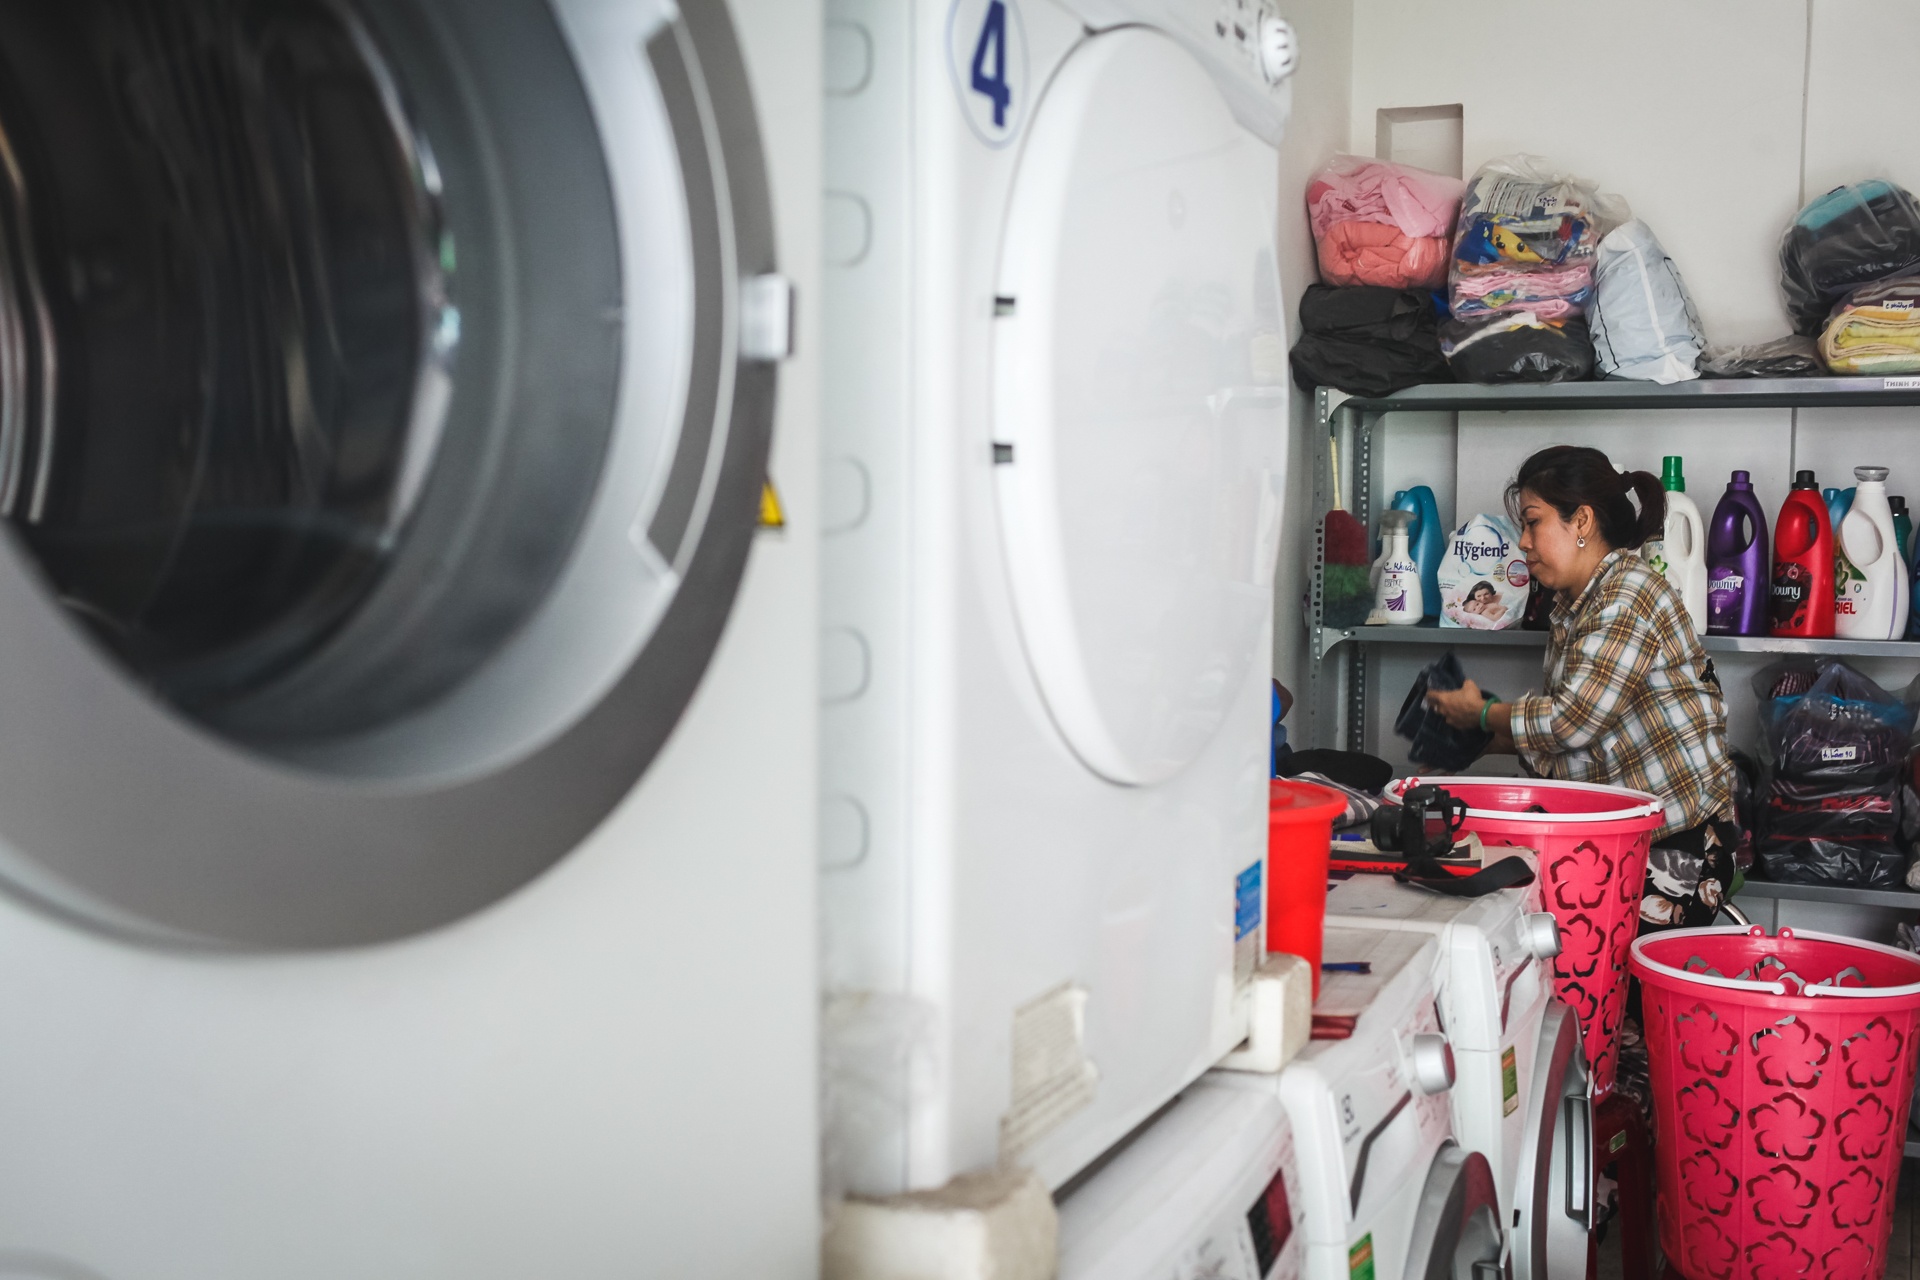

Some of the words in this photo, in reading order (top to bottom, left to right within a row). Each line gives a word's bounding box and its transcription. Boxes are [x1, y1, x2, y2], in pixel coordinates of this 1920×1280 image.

[970, 0, 1011, 127] 4
[1453, 540, 1510, 561] Hygiene
[1835, 602, 1857, 614] RIEL
